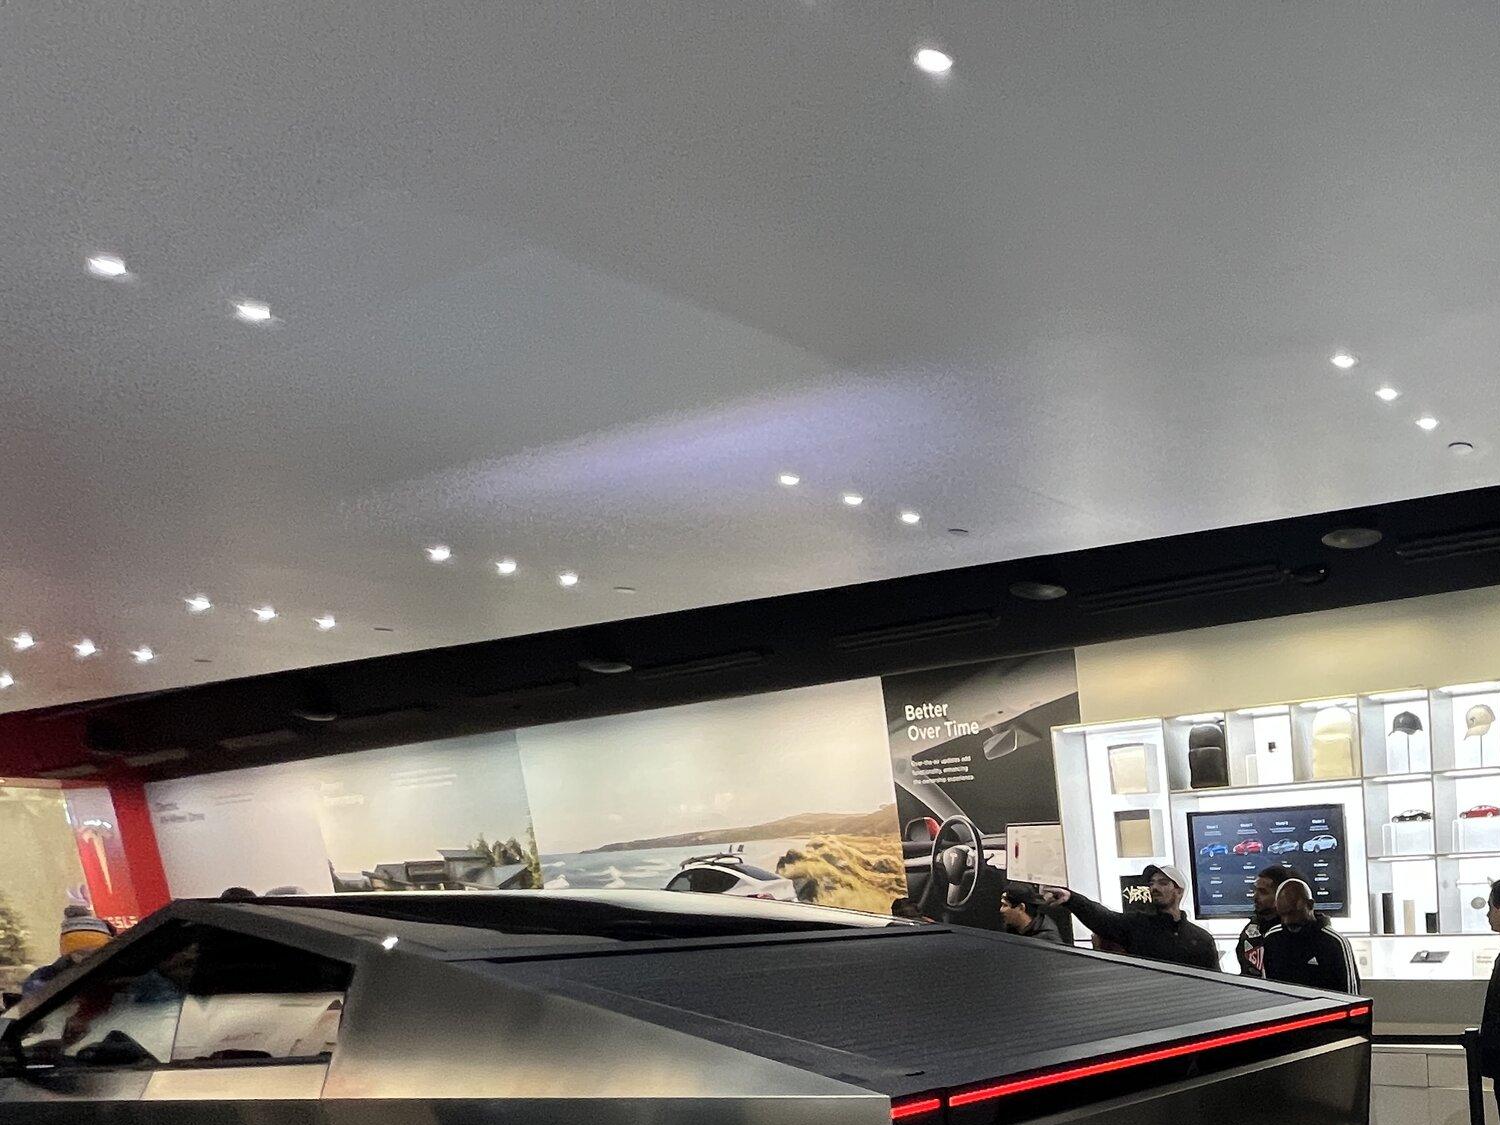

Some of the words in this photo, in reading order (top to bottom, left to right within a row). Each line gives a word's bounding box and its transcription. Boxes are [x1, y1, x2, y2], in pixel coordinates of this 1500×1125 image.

[904, 703, 948, 721] Better
[907, 724, 941, 741] Over
[943, 719, 980, 738] Time
